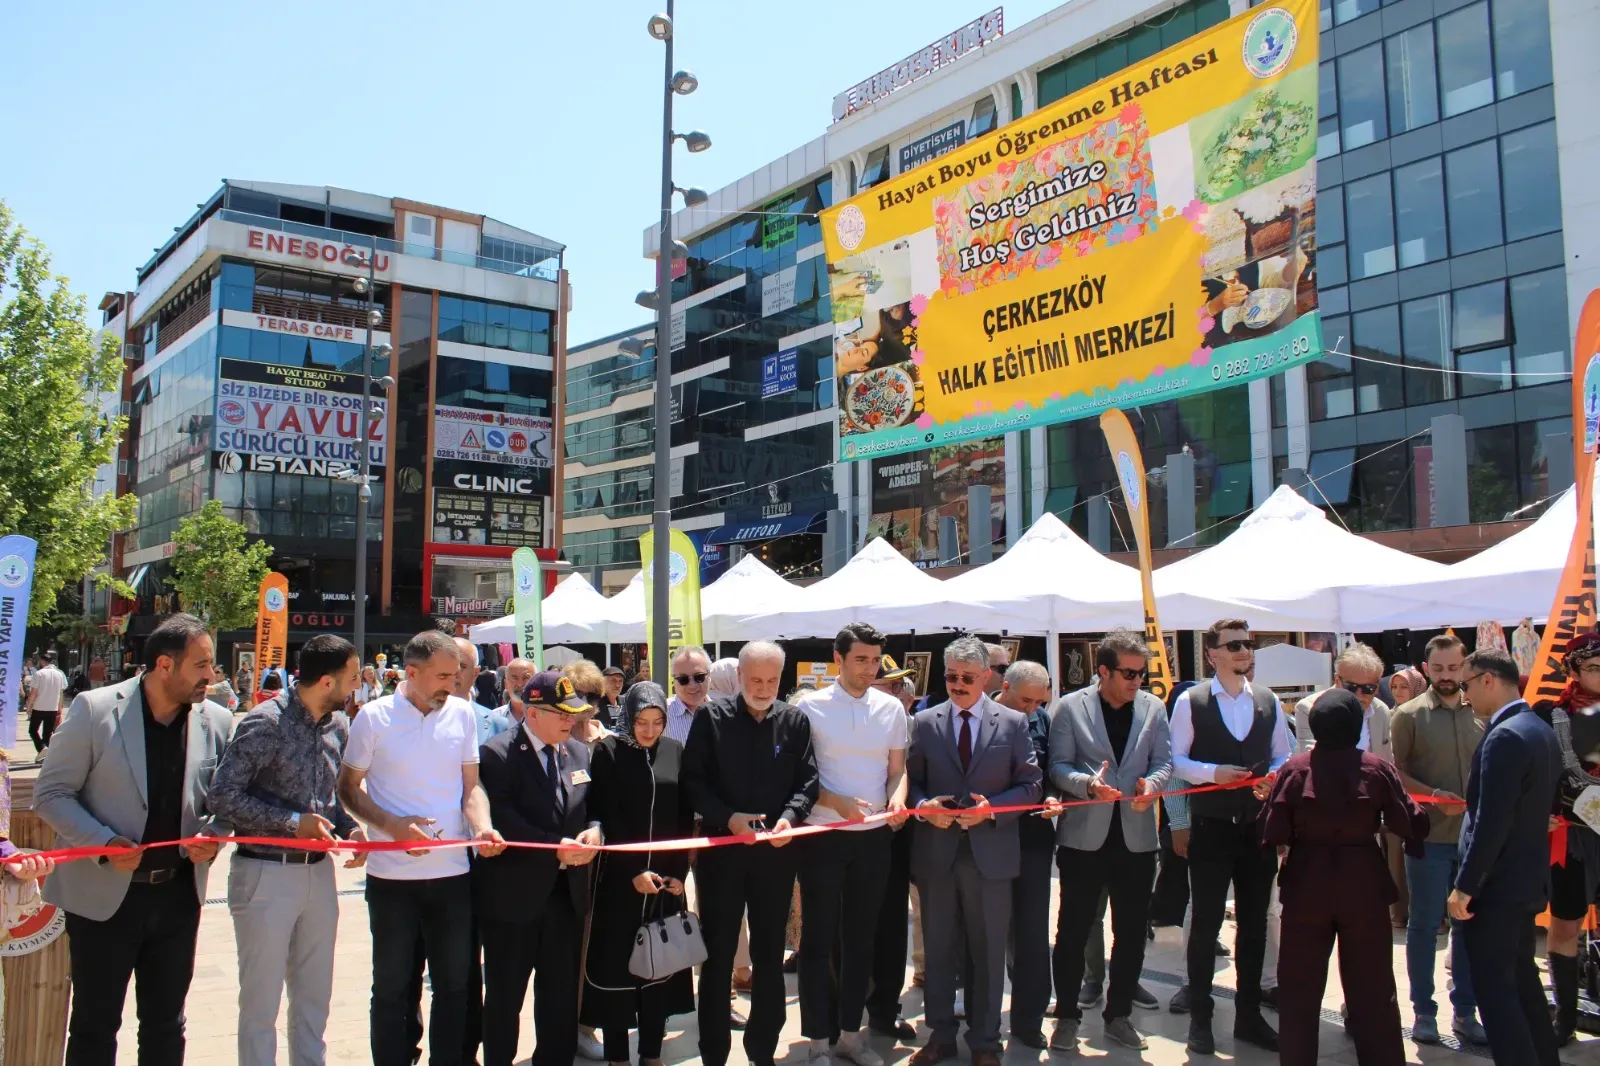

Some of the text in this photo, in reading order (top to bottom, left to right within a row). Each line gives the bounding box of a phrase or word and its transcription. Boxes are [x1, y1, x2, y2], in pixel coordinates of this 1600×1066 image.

[856, 10, 1000, 109] BURGER KING
[877, 48, 1219, 211] Hayat Boyu Öğrenme Haftası
[904, 126, 961, 160] DİYETİSYEN
[969, 160, 1107, 229] Sergimize
[959, 192, 1137, 272] Hoş Geldiniz
[248, 230, 389, 272] ENESOĞLU
[983, 274, 1108, 342] ÇERKEZKÖY
[256, 316, 353, 340] TERAS CAFE
[938, 302, 1175, 396] HALK EĞİTİMİ MERKEZİ
[1211, 364, 1222, 381] 0
[1226, 358, 1250, 379] 282
[1254, 351, 1275, 372] 726
[1292, 336, 1310, 356] 80
[266, 366, 346, 383] HAYAT BEAUTY
[284, 377, 327, 388] STUDIO
[221, 382, 245, 396] SİZ
[249, 386, 301, 402] BİZEDE
[304, 391, 328, 405] BİR
[219, 429, 384, 463] SÜRÜCÜ KURU
[436, 449, 455, 457] 0282
[509, 439, 526, 447] DUR
[453, 473, 533, 494] CLINIC
[447, 512, 483, 521] İSTANBUL
[762, 502, 792, 516] EATFORD
[735, 523, 782, 540] EATFORD
[444, 595, 488, 615] Meydan
[292, 612, 345, 626] OĞLU
